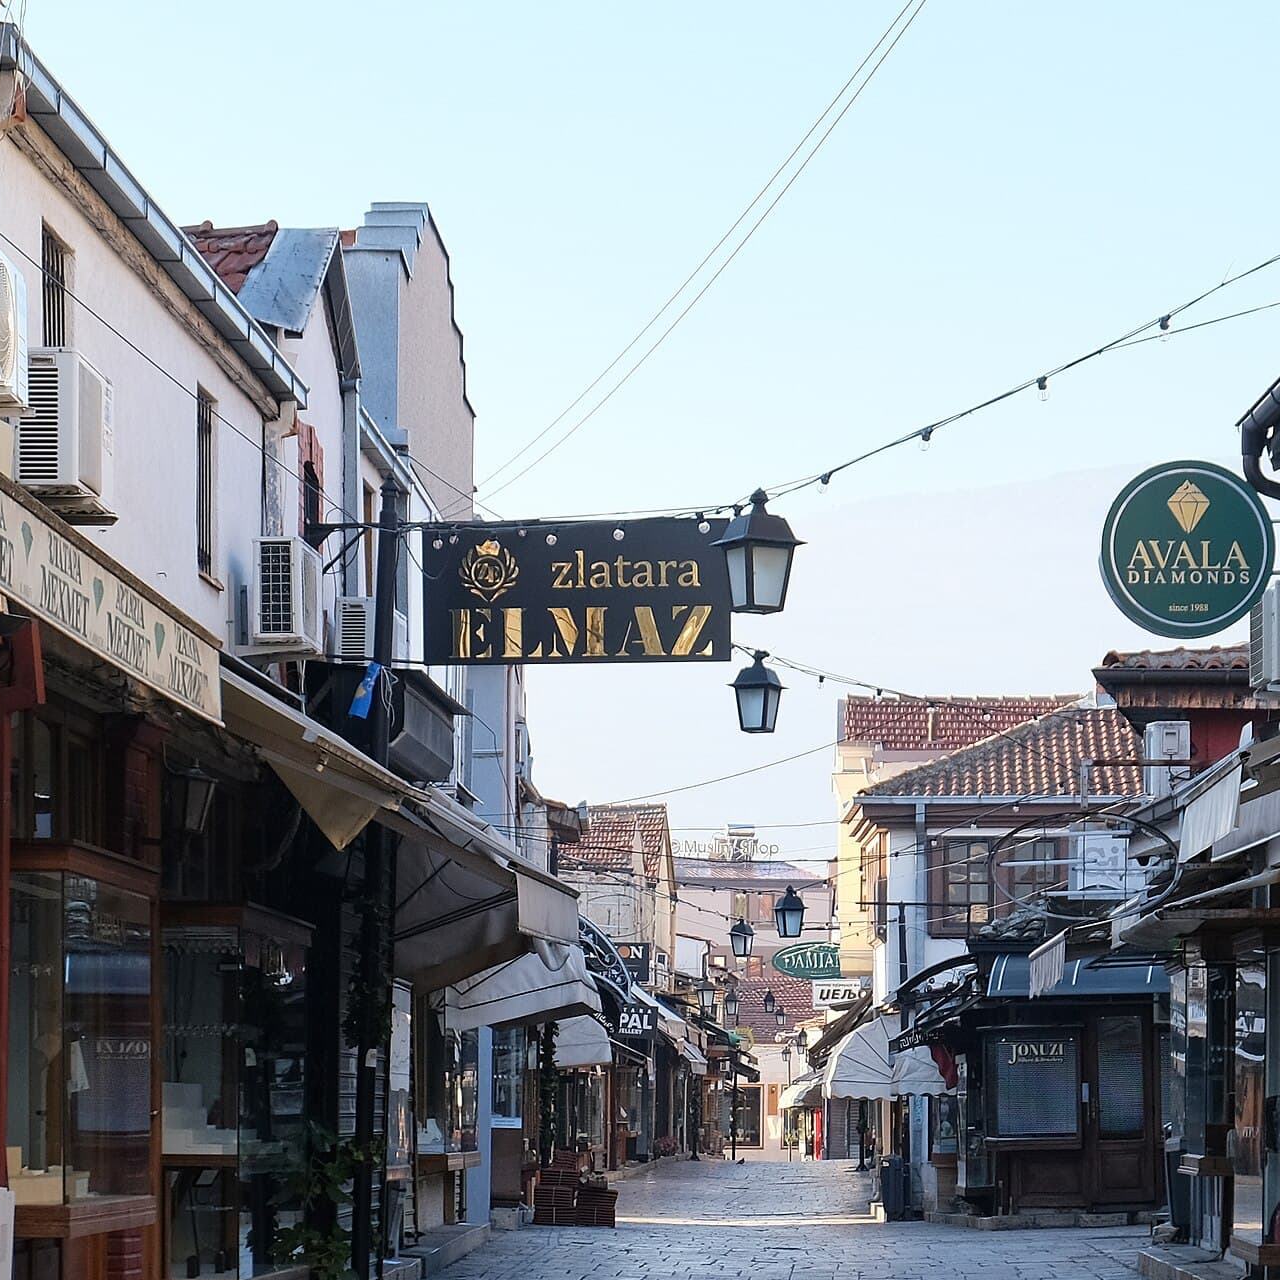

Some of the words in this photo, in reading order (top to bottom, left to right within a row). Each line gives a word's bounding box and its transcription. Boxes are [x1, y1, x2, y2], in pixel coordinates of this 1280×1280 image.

[1127, 540, 1250, 569] AVALA
[551, 550, 702, 589] zlatara
[1128, 570, 1250, 584] DIAMONDS
[1168, 603, 1188, 612] since
[448, 605, 713, 658] ELMAZ
[1008, 1043, 1063, 1064] JONUZI
